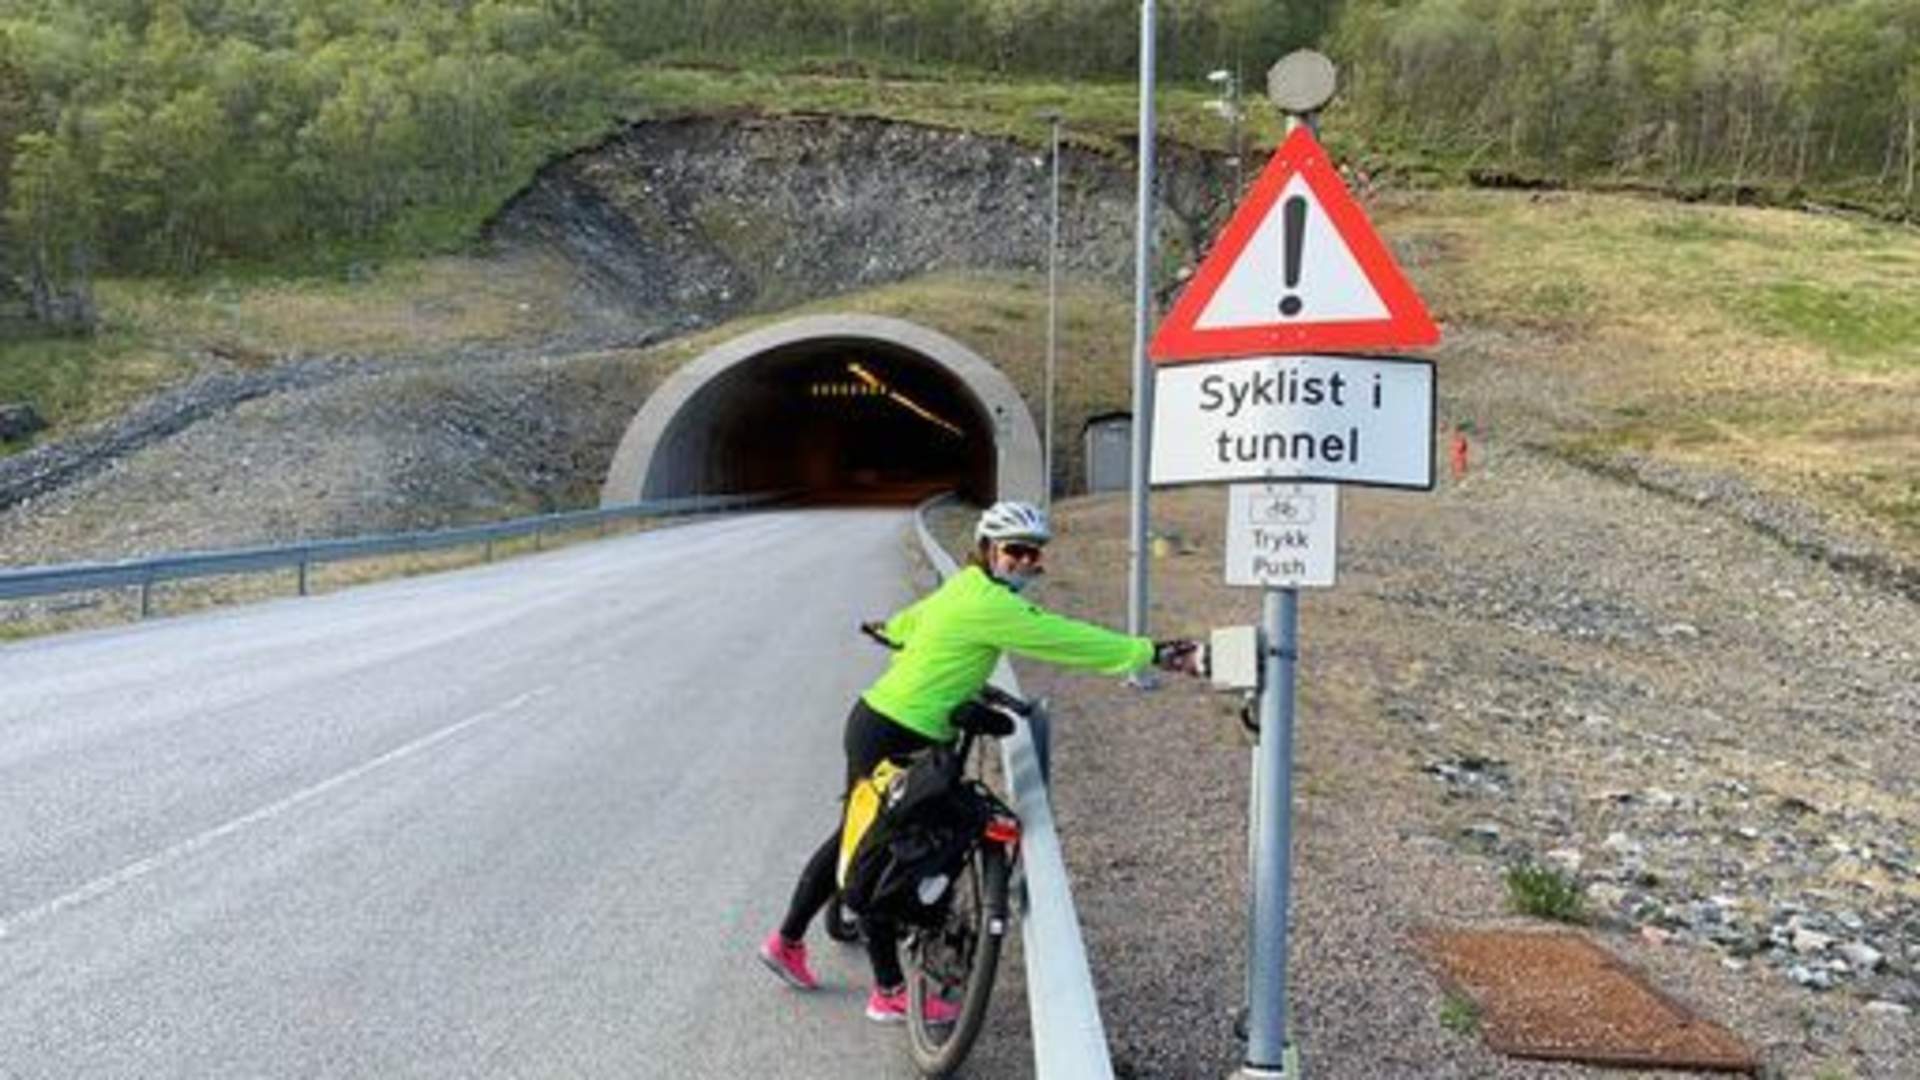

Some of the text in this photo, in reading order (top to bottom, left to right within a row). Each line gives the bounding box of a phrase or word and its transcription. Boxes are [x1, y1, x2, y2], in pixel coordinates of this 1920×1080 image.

[1199, 369, 1382, 417] Syklist i
[1216, 426, 1359, 463] tunnel
[1253, 528, 1309, 552] Trykk
[1252, 556, 1306, 577] Push
